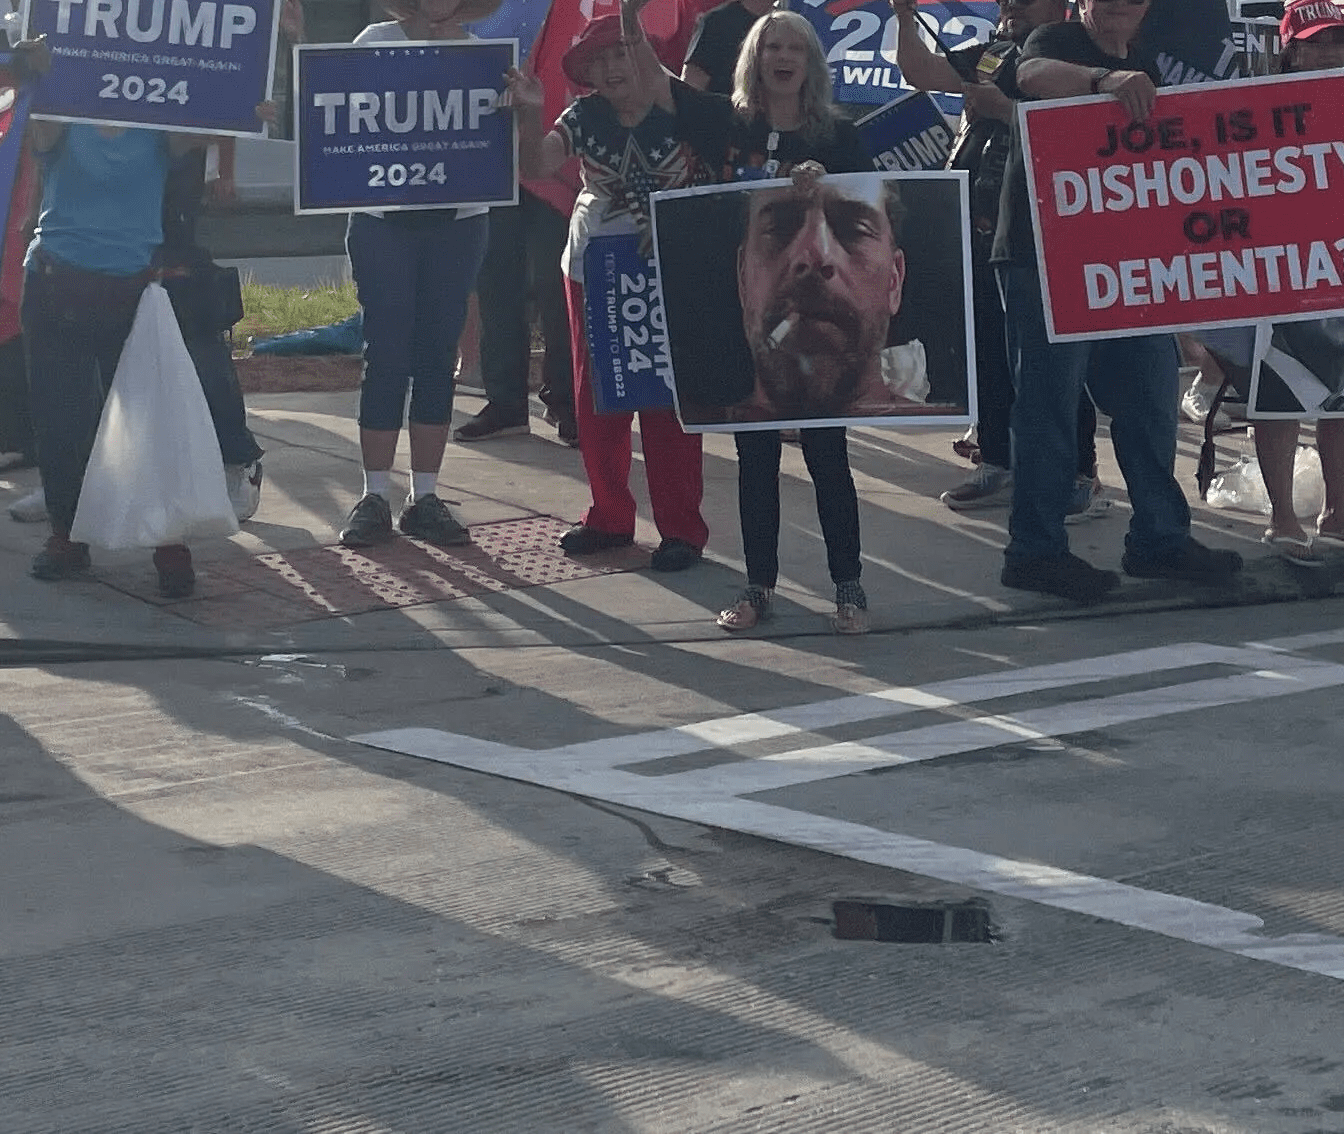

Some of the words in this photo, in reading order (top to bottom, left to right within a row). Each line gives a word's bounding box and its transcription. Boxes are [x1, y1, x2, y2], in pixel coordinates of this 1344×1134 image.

[99, 72, 189, 105] 2024
[314, 88, 498, 135] TRUMP
[1096, 115, 1202, 158] JOE,
[1216, 109, 1257, 145] IS
[1271, 102, 1312, 138] IT
[322, 146, 354, 155] MAKE
[357, 143, 408, 153] AMERICA
[367, 162, 447, 187] 2024
[1182, 207, 1253, 244] OR
[606, 288, 618, 333] TRUMP
[620, 272, 652, 373] 2024
